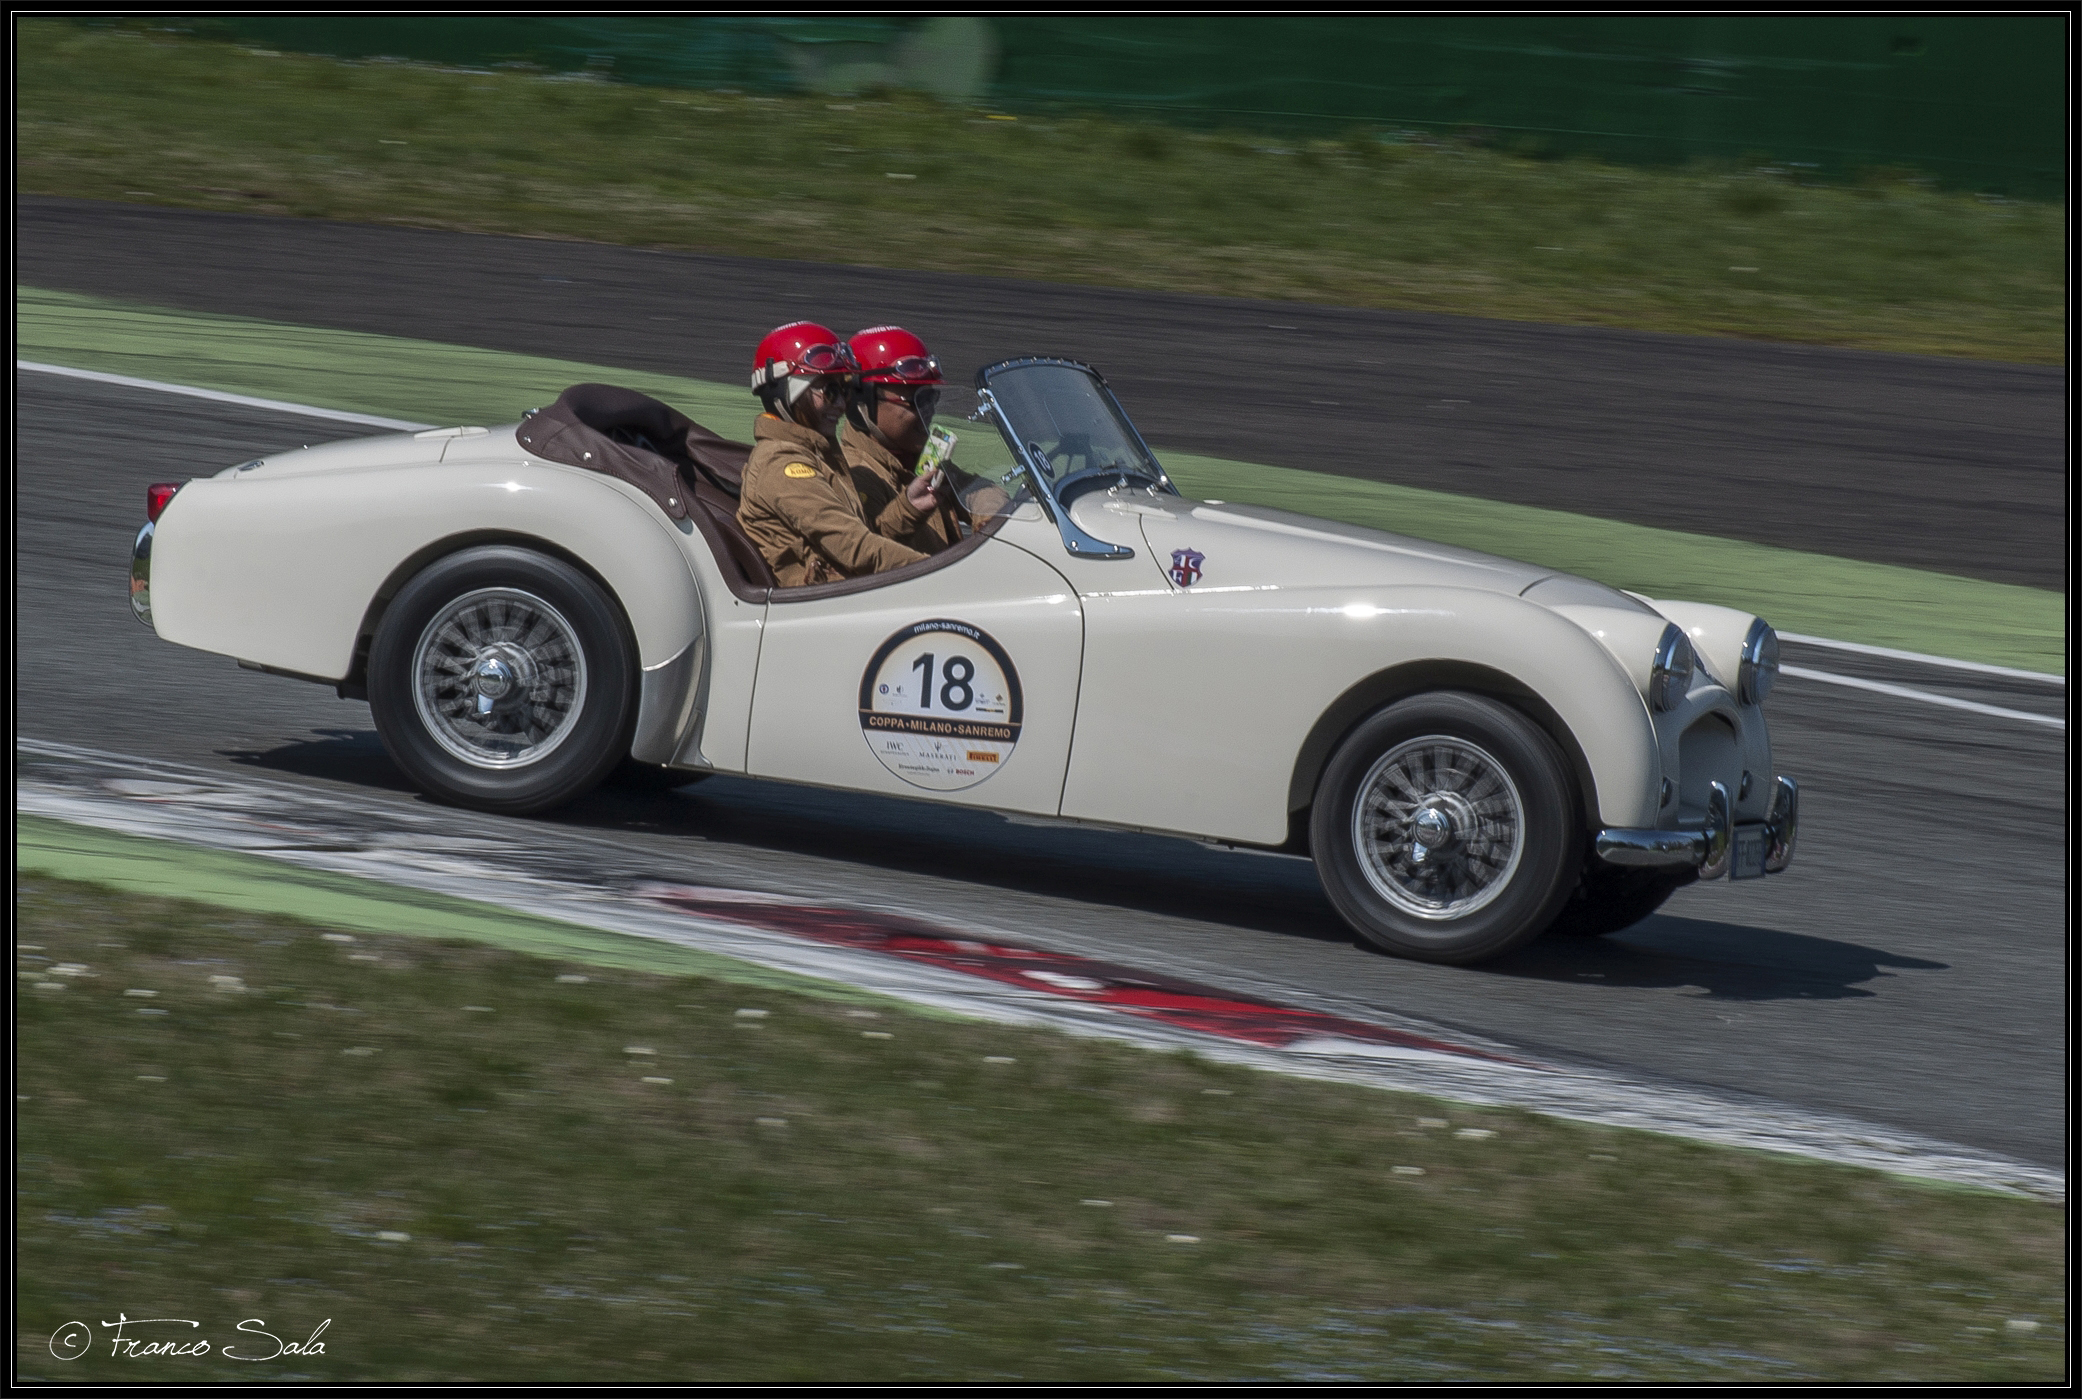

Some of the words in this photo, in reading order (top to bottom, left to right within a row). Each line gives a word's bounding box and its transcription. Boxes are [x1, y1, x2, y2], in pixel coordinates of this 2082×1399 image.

[1033, 450, 1050, 471] 18
[914, 621, 980, 640] milano-sanremo.it
[912, 651, 975, 711] 18
[869, 715, 905, 730] COPPA
[910, 721, 952, 733] MILANO
[957, 725, 1011, 739] SANREMO
[886, 741, 904, 751] IWC
[919, 752, 957, 761] MASERATI
[955, 768, 975, 776] BOSCH
